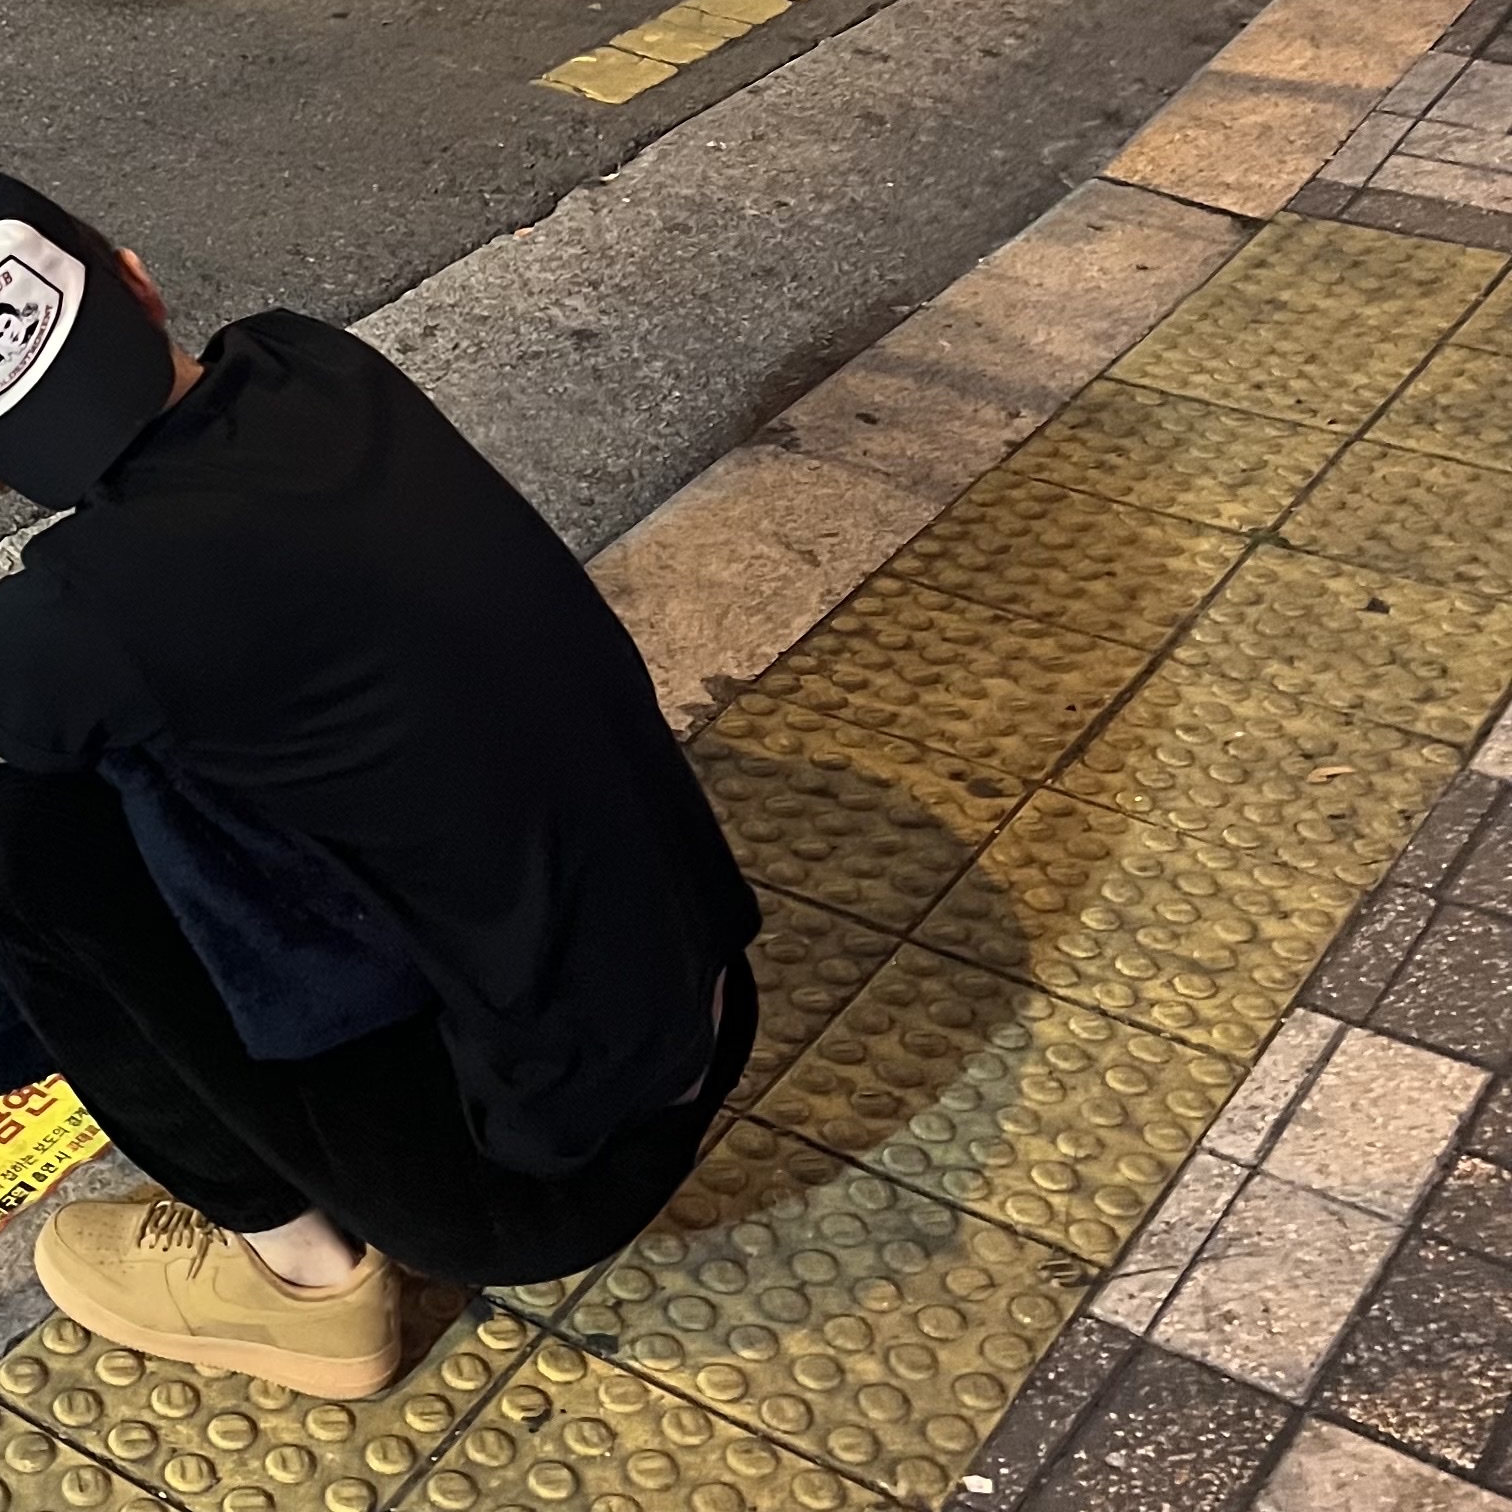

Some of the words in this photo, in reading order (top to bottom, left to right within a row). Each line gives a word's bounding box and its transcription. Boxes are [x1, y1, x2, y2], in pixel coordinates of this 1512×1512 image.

[1, 1154, 40, 1182] 접하는
[33, 1126, 71, 1154] 보도의
[55, 1151, 72, 1163] 시
